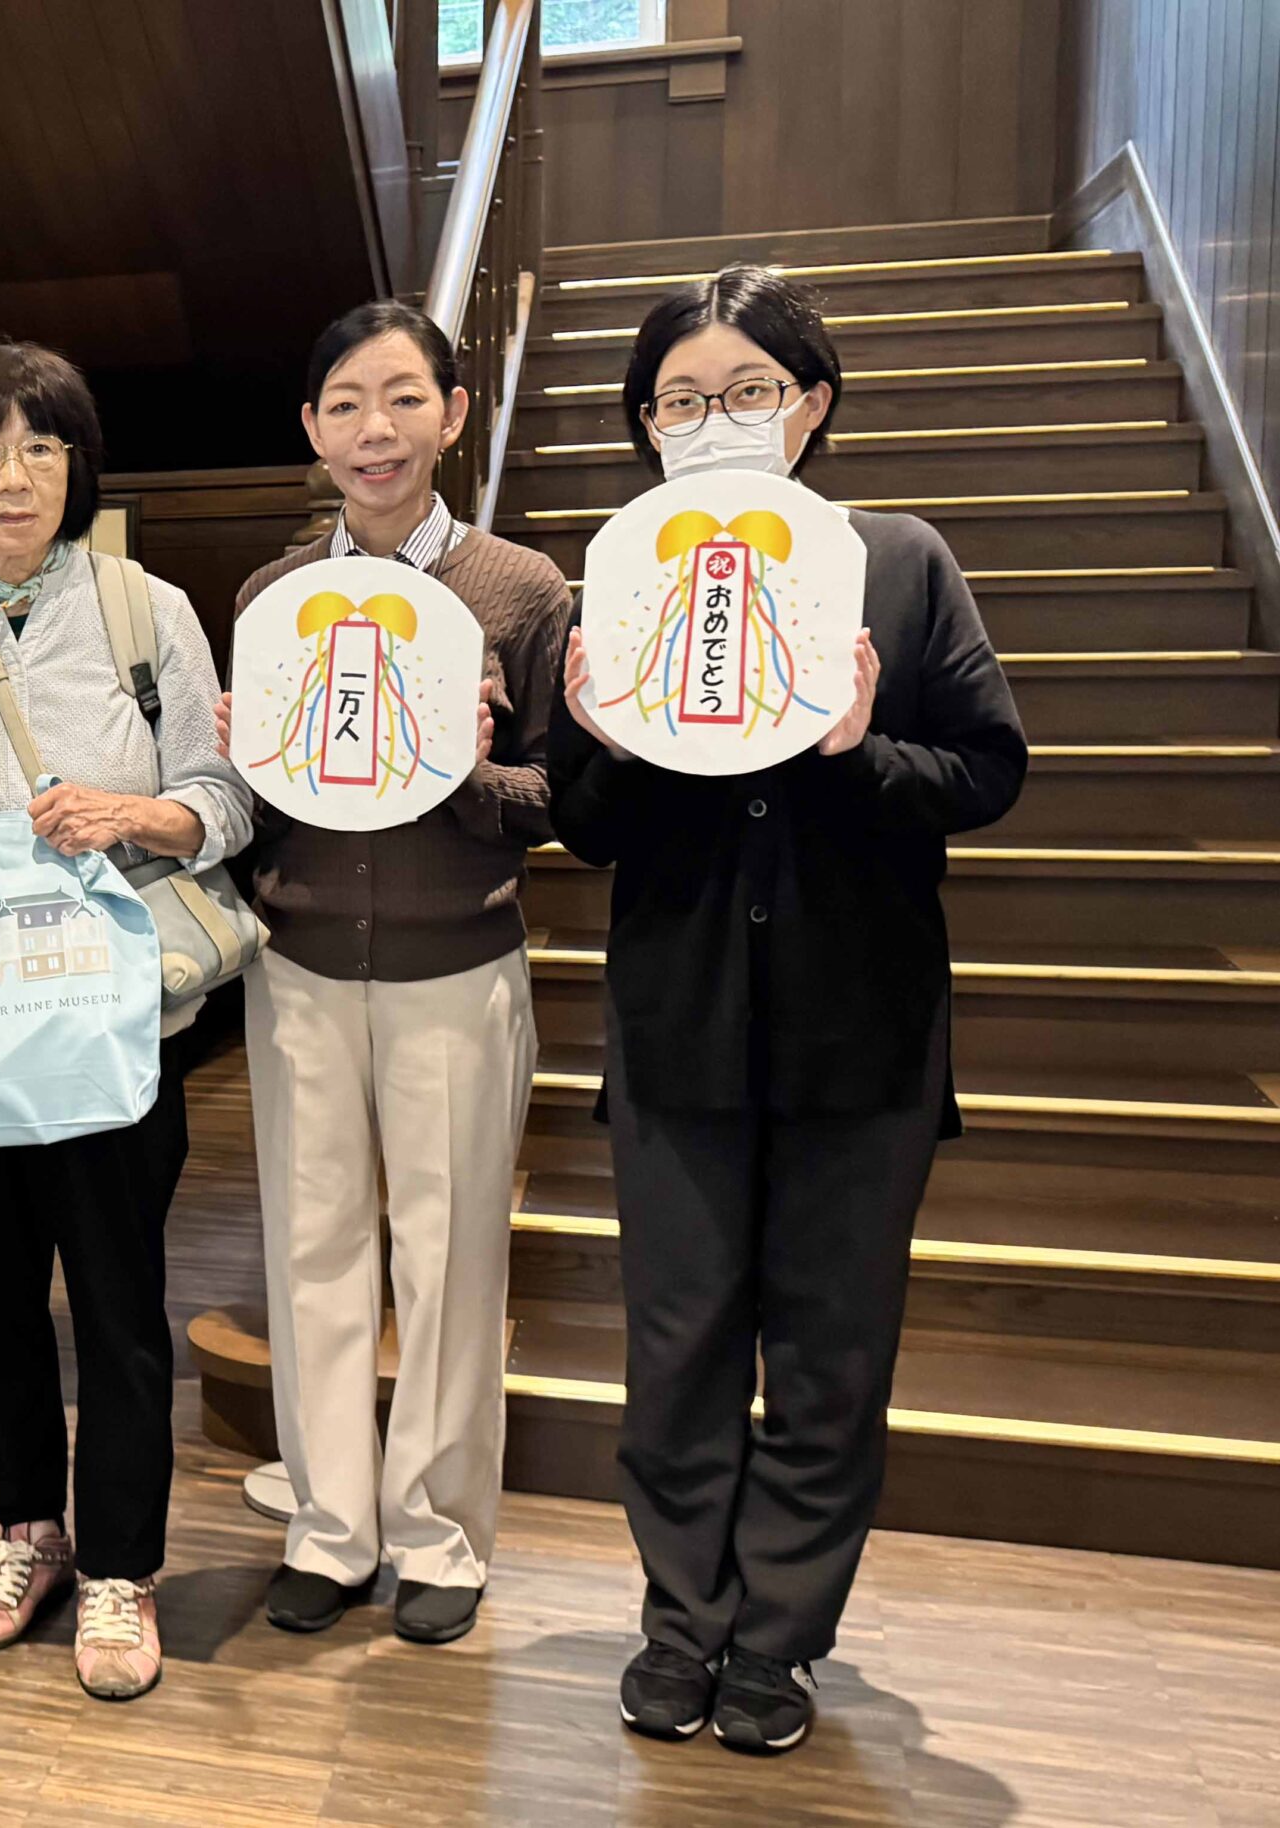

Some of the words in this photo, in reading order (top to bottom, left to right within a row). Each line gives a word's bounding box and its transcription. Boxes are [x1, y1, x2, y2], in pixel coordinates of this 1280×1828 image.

[699, 584, 732, 714] おめでとう
[334, 672, 368, 743] 一万人
[14, 999, 54, 1015] MINE
[58, 993, 122, 1008] MUSEUM
